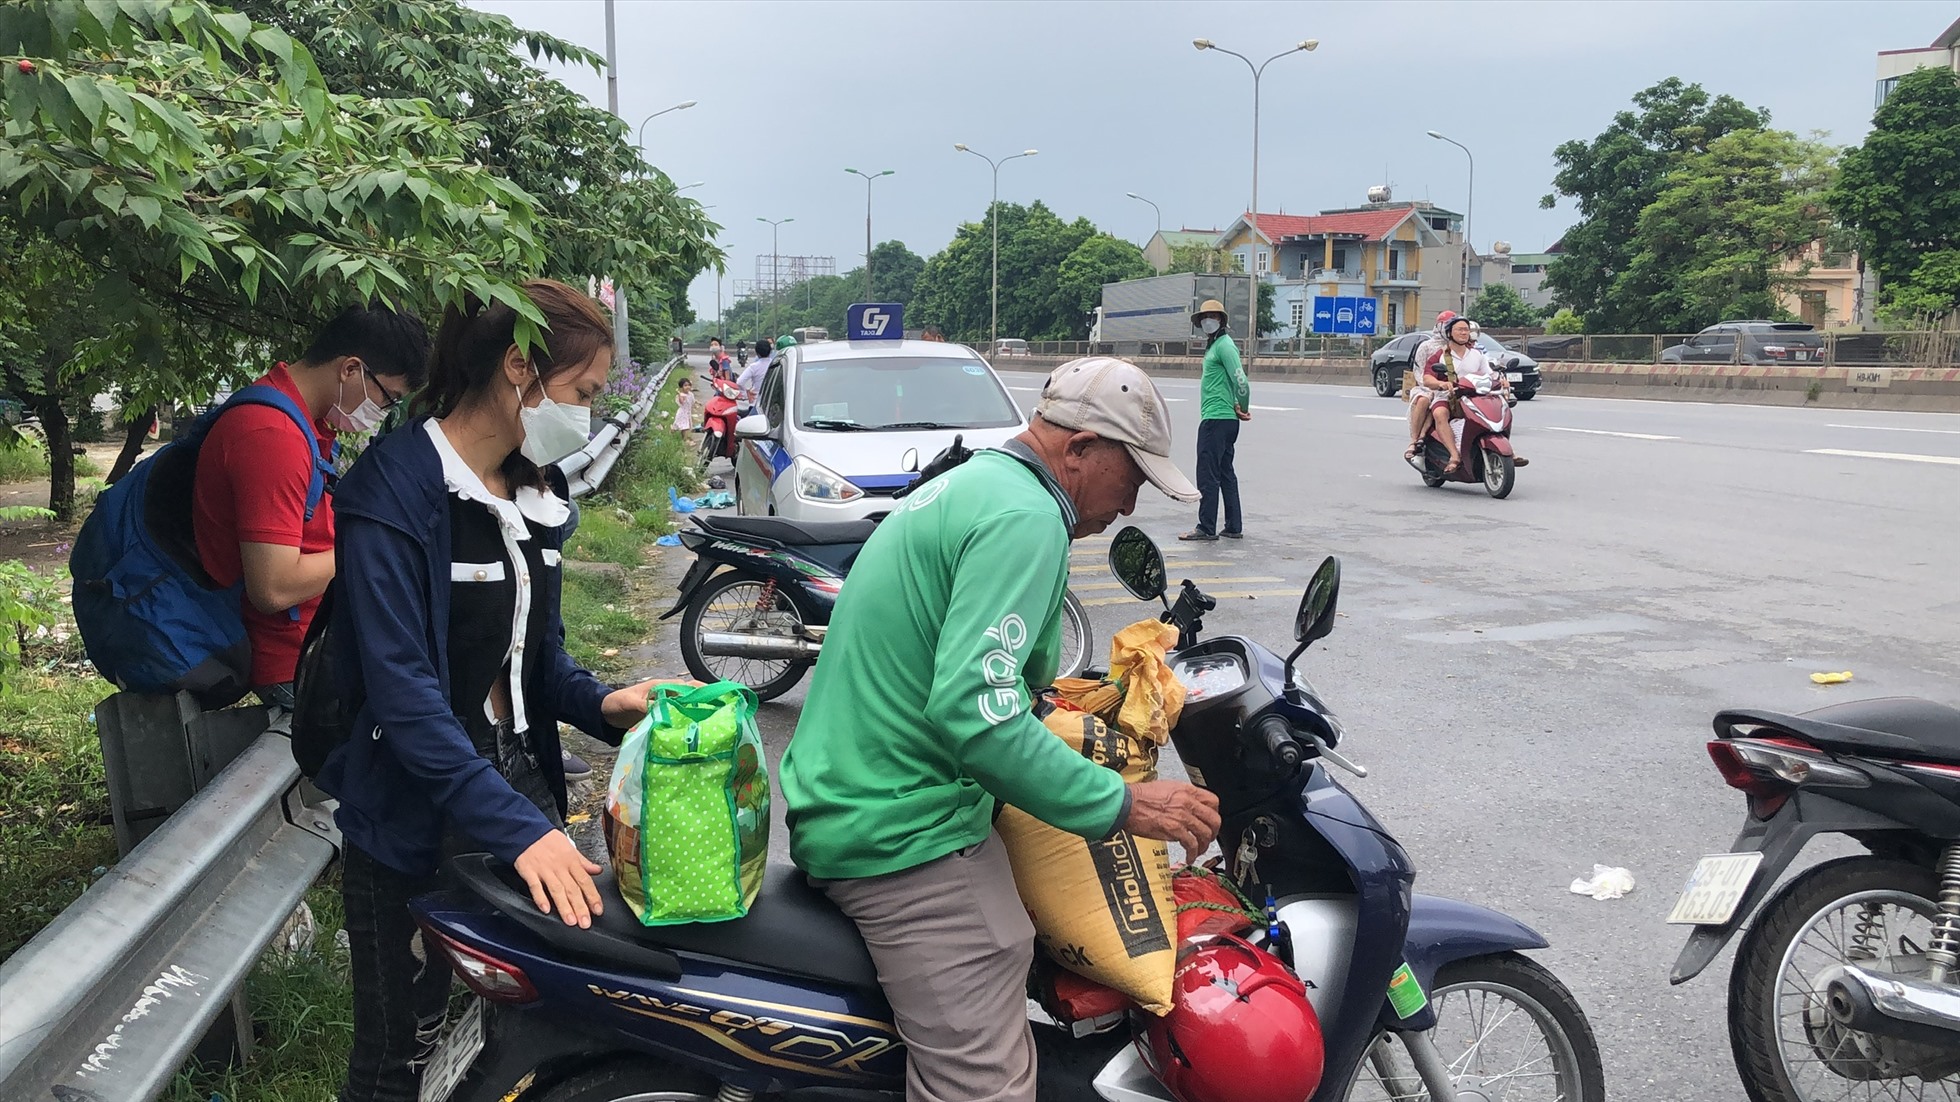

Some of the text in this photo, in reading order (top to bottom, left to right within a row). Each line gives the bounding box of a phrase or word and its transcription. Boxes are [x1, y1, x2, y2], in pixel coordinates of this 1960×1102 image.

[862, 307, 891, 336] G7
[1235, 368, 1247, 396] Grab
[978, 613, 1027, 726] Grab
[1116, 738, 1128, 759] 35
[1103, 831, 1149, 922] biolück
[1675, 890, 1738, 920] 163.03
[1059, 942, 1095, 967] ck
[587, 983, 710, 1016] WAVE
